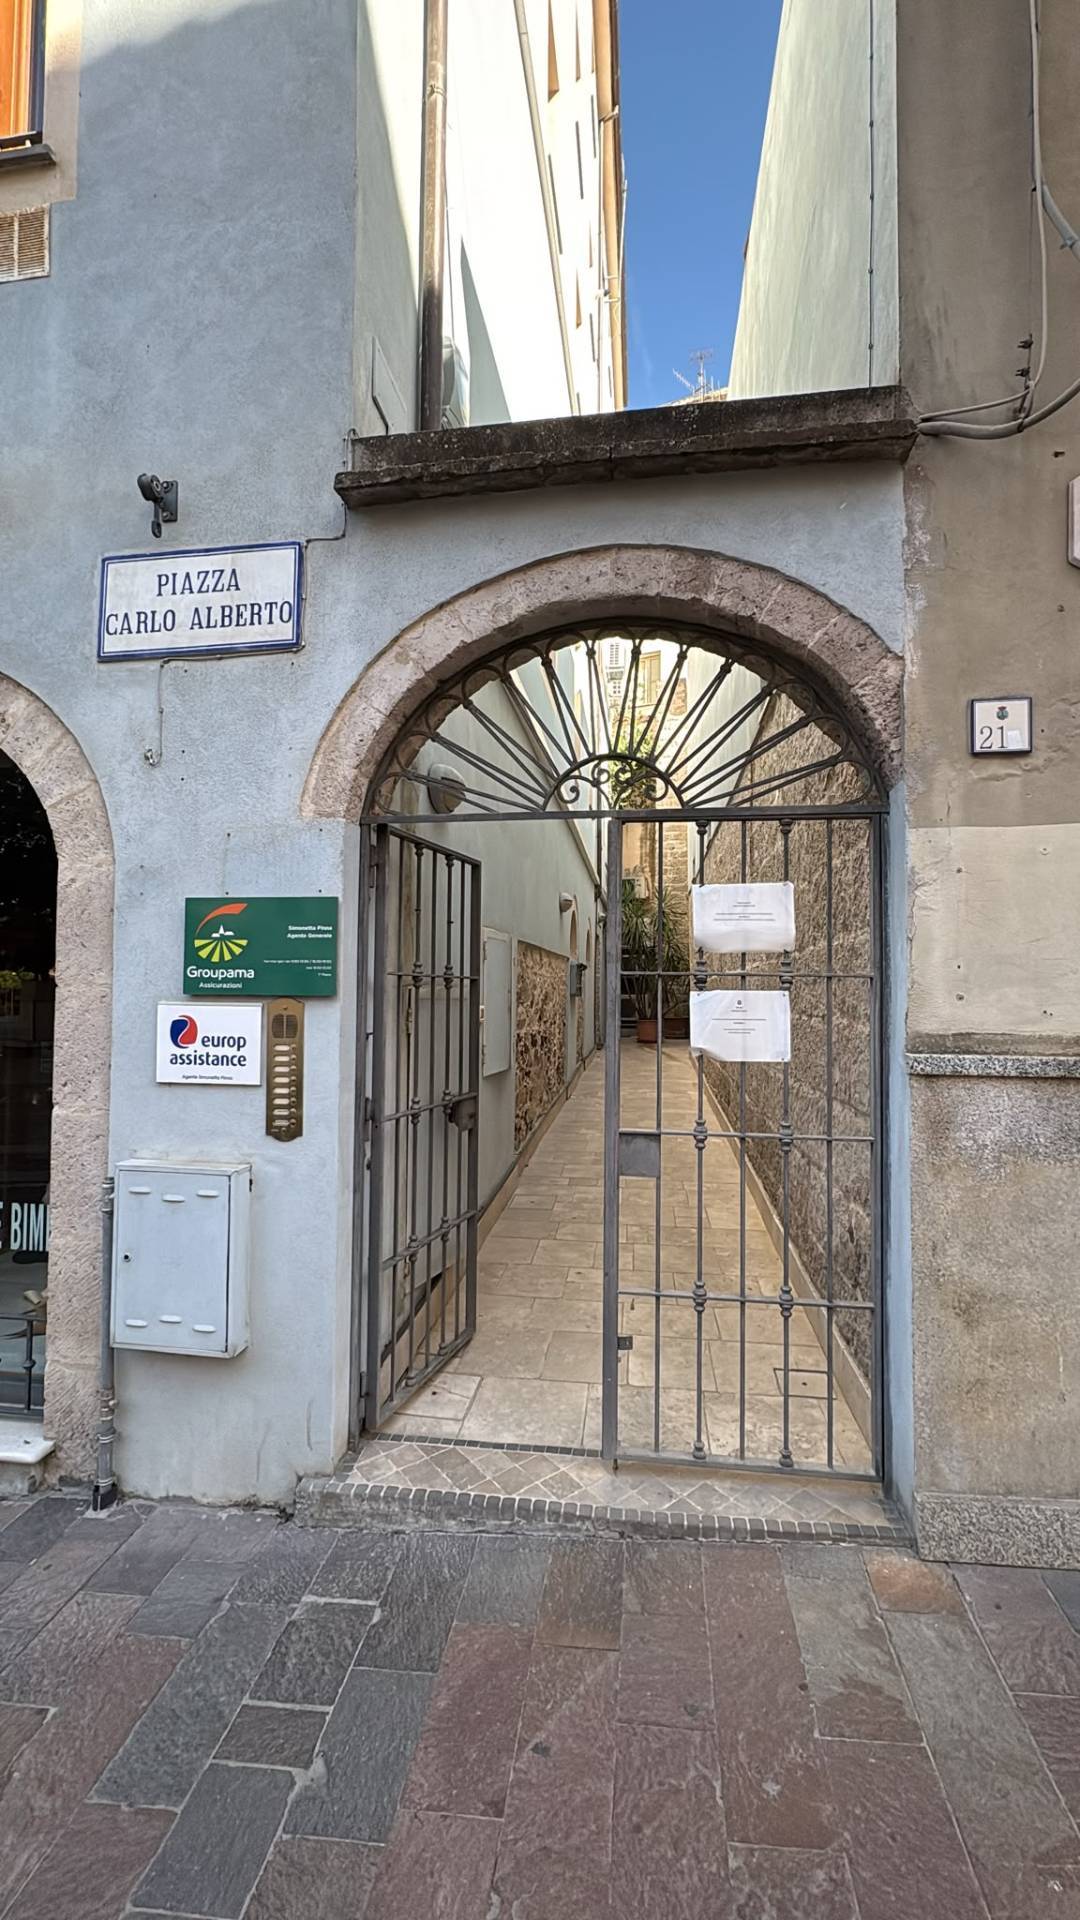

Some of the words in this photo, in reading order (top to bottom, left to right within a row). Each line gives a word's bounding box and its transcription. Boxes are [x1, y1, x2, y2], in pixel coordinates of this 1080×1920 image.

[156, 568, 241, 597] PIAZZA
[105, 609, 176, 636] CARLO
[189, 600, 292, 630] ALBERTO
[979, 725, 1008, 749] 21
[186, 965, 255, 981] Groupama
[198, 981, 243, 989] Assicurazioni
[200, 1034, 247, 1052] europ
[169, 1050, 247, 1067] assistance
